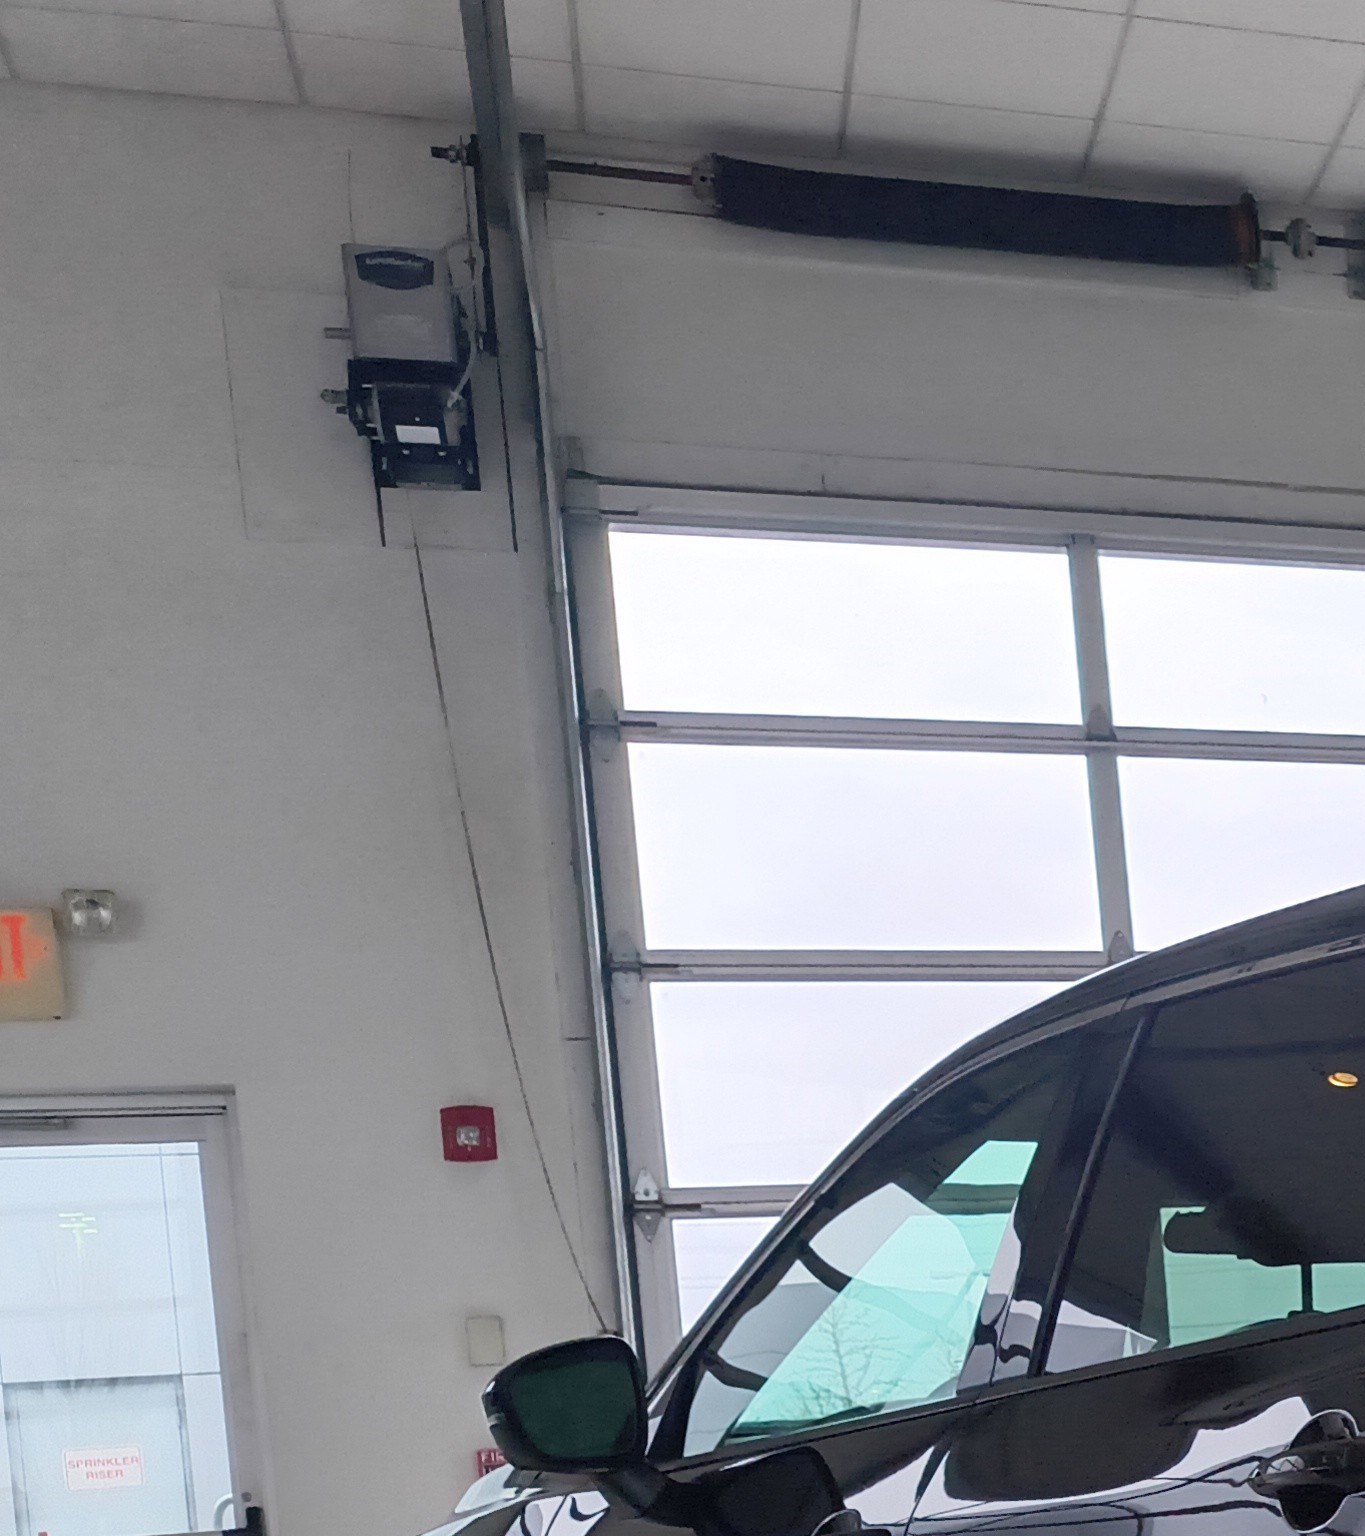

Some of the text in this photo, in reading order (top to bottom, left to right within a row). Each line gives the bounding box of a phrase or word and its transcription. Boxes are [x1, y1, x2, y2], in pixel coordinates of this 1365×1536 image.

[0, 913, 28, 981] T
[67, 1455, 140, 1470] SPRINKLER
[86, 1468, 125, 1480] RISER
